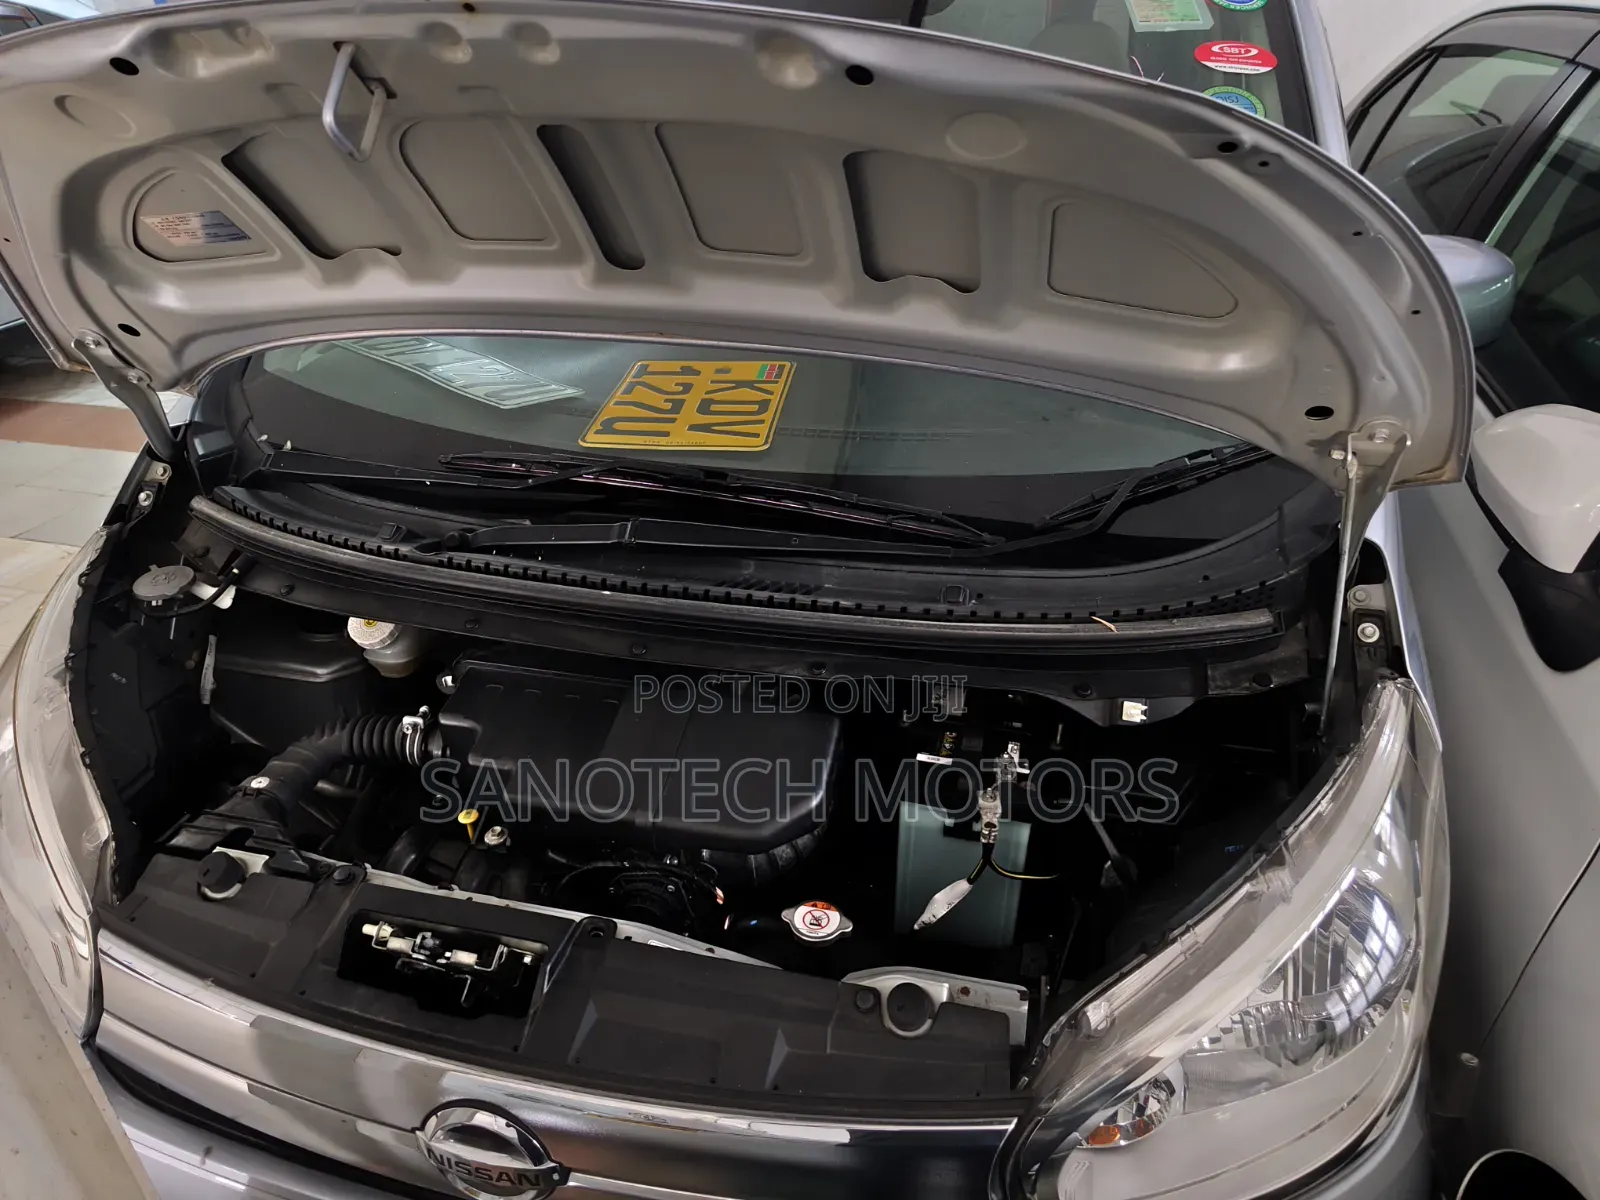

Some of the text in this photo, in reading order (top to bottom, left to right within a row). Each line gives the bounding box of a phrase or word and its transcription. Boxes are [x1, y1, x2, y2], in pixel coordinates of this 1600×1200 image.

[1223, 46, 1246, 55] SBT
[592, 363, 702, 437] 127U
[686, 379, 780, 439] KDV
[427, 1147, 541, 1187] NISSAN
